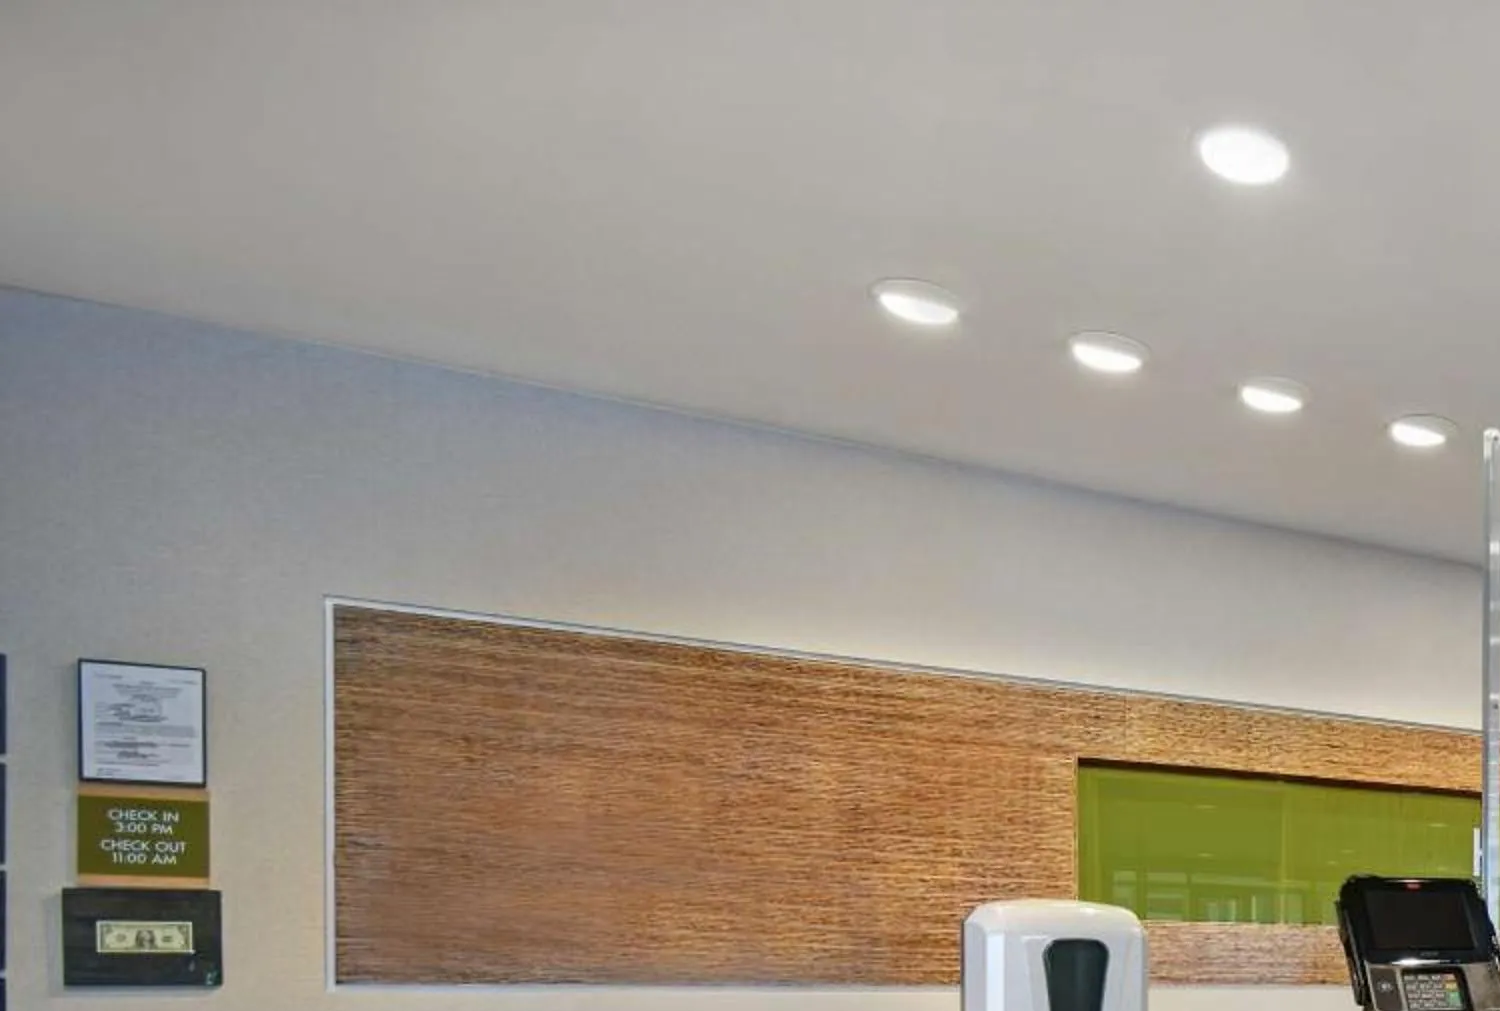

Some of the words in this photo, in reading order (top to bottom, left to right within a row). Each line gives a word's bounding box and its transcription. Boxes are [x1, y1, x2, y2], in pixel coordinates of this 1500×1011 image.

[107, 808, 158, 821] CHECK
[163, 811, 179, 823] IN
[115, 821, 147, 833] 3:00
[151, 823, 173, 835] PM
[100, 839, 151, 852] CHECK
[155, 841, 185, 854] OUT
[113, 852, 147, 864] 11:00
[152, 854, 177, 865] AM
